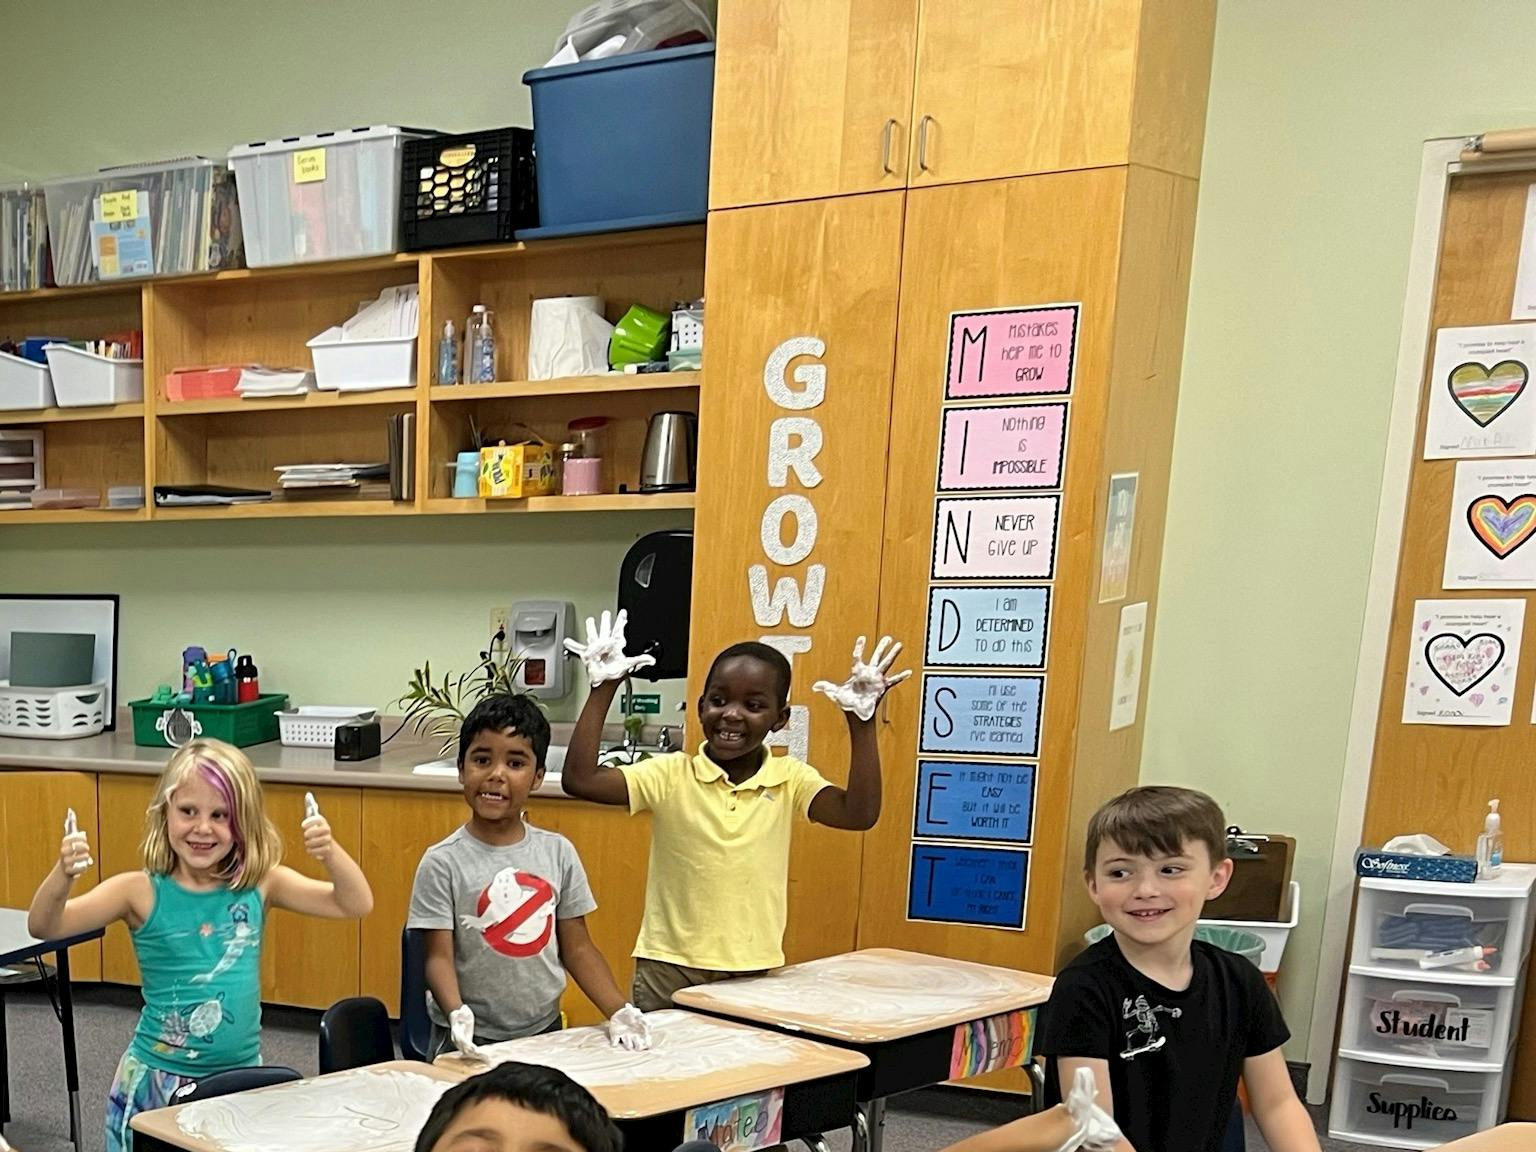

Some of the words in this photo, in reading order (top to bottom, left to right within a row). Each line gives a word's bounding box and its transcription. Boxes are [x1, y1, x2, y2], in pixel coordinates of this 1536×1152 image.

[1015, 367, 1045, 383] GROW
[992, 458, 1047, 475] IMPOSSIBLE
[995, 514, 1035, 532] NEVER
[1003, 598, 1018, 612] am
[976, 618, 1034, 632] DETERMINED
[973, 715, 1022, 729] STRATEGIES
[981, 787, 1005, 799] EASY
[971, 816, 1001, 829] WORTH
[1002, 817, 1010, 829] IT
[1376, 1010, 1471, 1043] Student
[1366, 1092, 1458, 1132] Supplies
